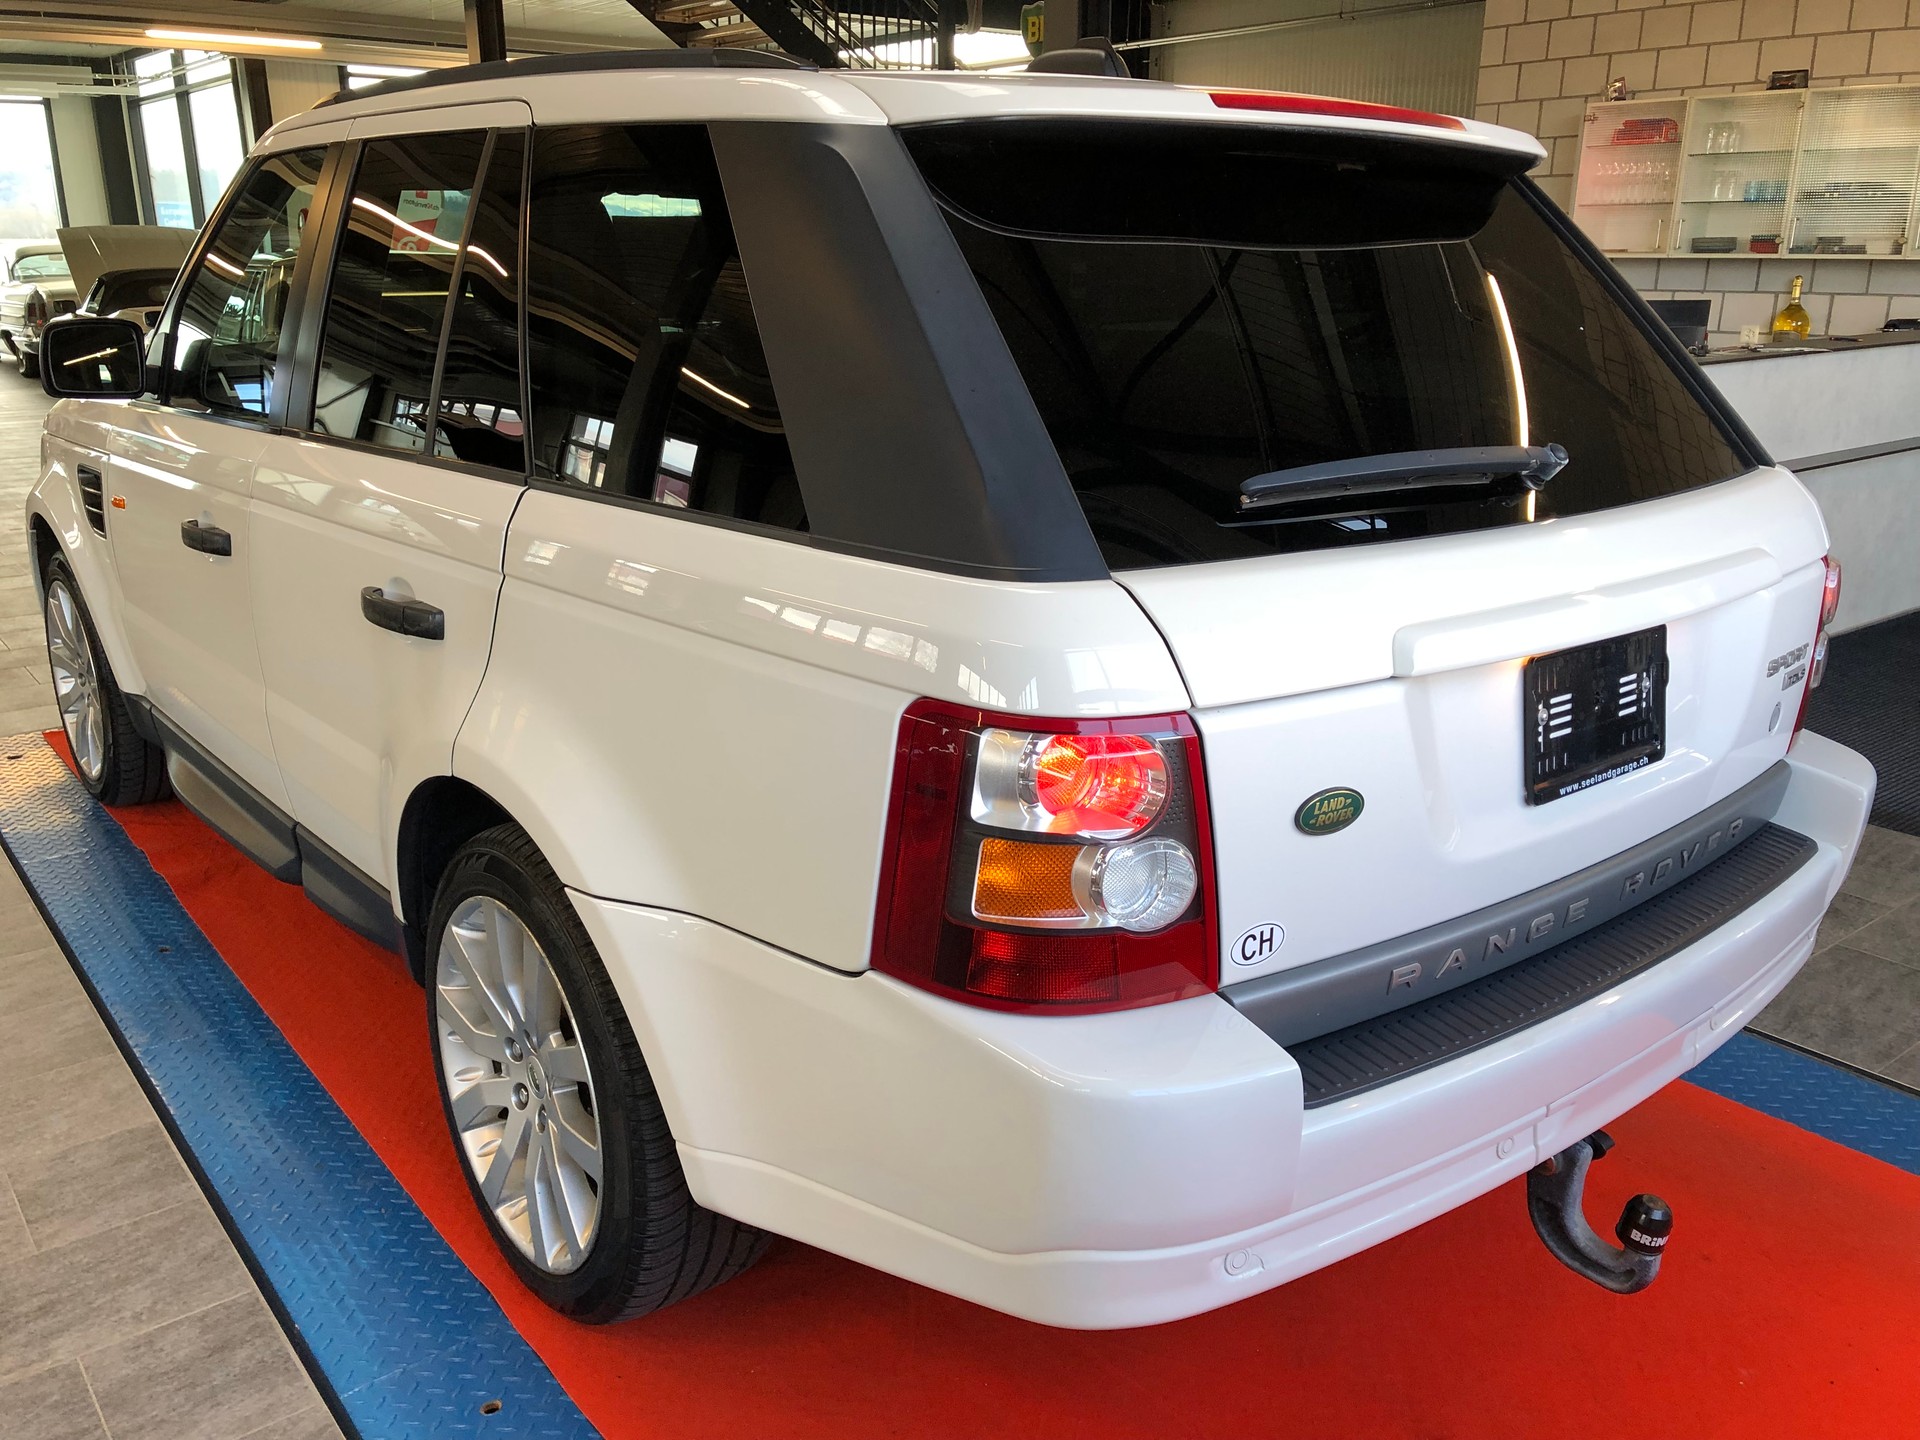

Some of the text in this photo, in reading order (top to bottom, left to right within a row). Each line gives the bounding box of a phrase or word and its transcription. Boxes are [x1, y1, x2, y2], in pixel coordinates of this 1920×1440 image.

[1766, 642, 1810, 678] SPORT
[1559, 755, 1649, 796] www.seelandgarage.ch
[1314, 796, 1345, 815] LAND
[1315, 806, 1354, 827] ROVER
[1386, 816, 1744, 996] RANGE ROVER
[1241, 926, 1274, 962] CH
